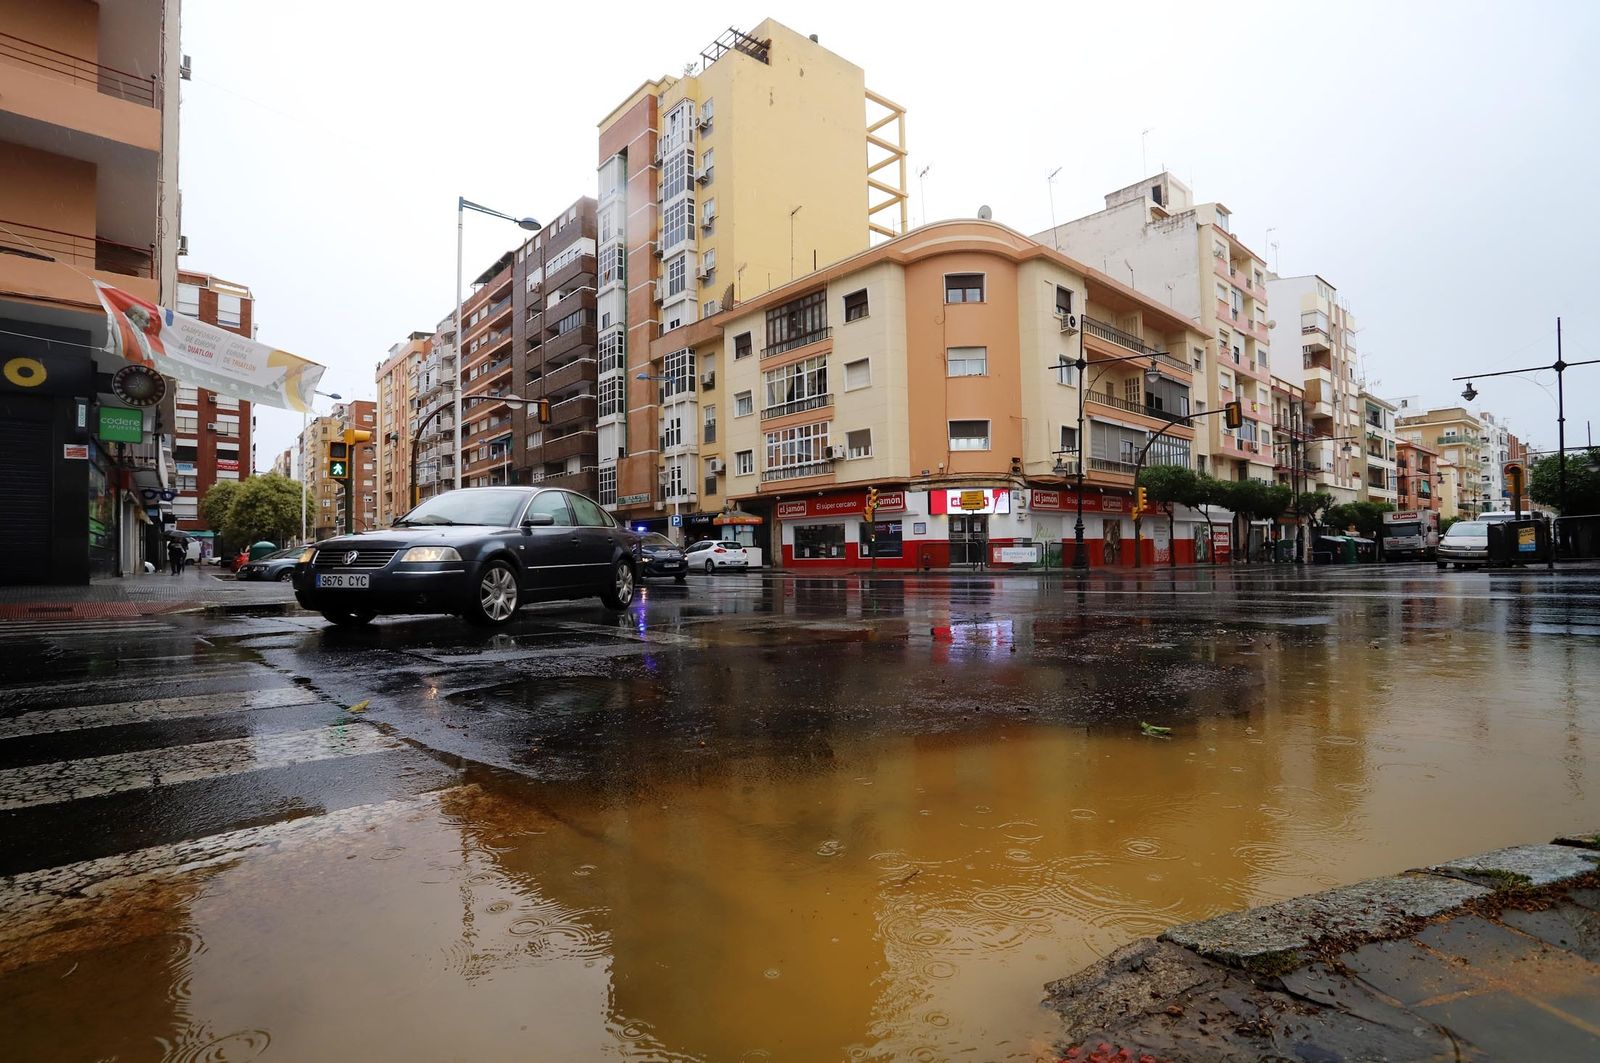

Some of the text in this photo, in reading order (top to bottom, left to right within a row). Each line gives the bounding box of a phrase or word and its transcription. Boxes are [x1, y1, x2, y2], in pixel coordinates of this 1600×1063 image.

[194, 338, 217, 350] EUROPA
[100, 417, 141, 427] codere
[107, 424, 141, 432] APUESTAS
[1035, 493, 1058, 505] el jamón
[785, 502, 805, 514] jamón
[821, 502, 835, 511] súper
[835, 501, 857, 510] cercano
[673, 516, 680, 526] P
[321, 575, 367, 587] 9676 CYC
